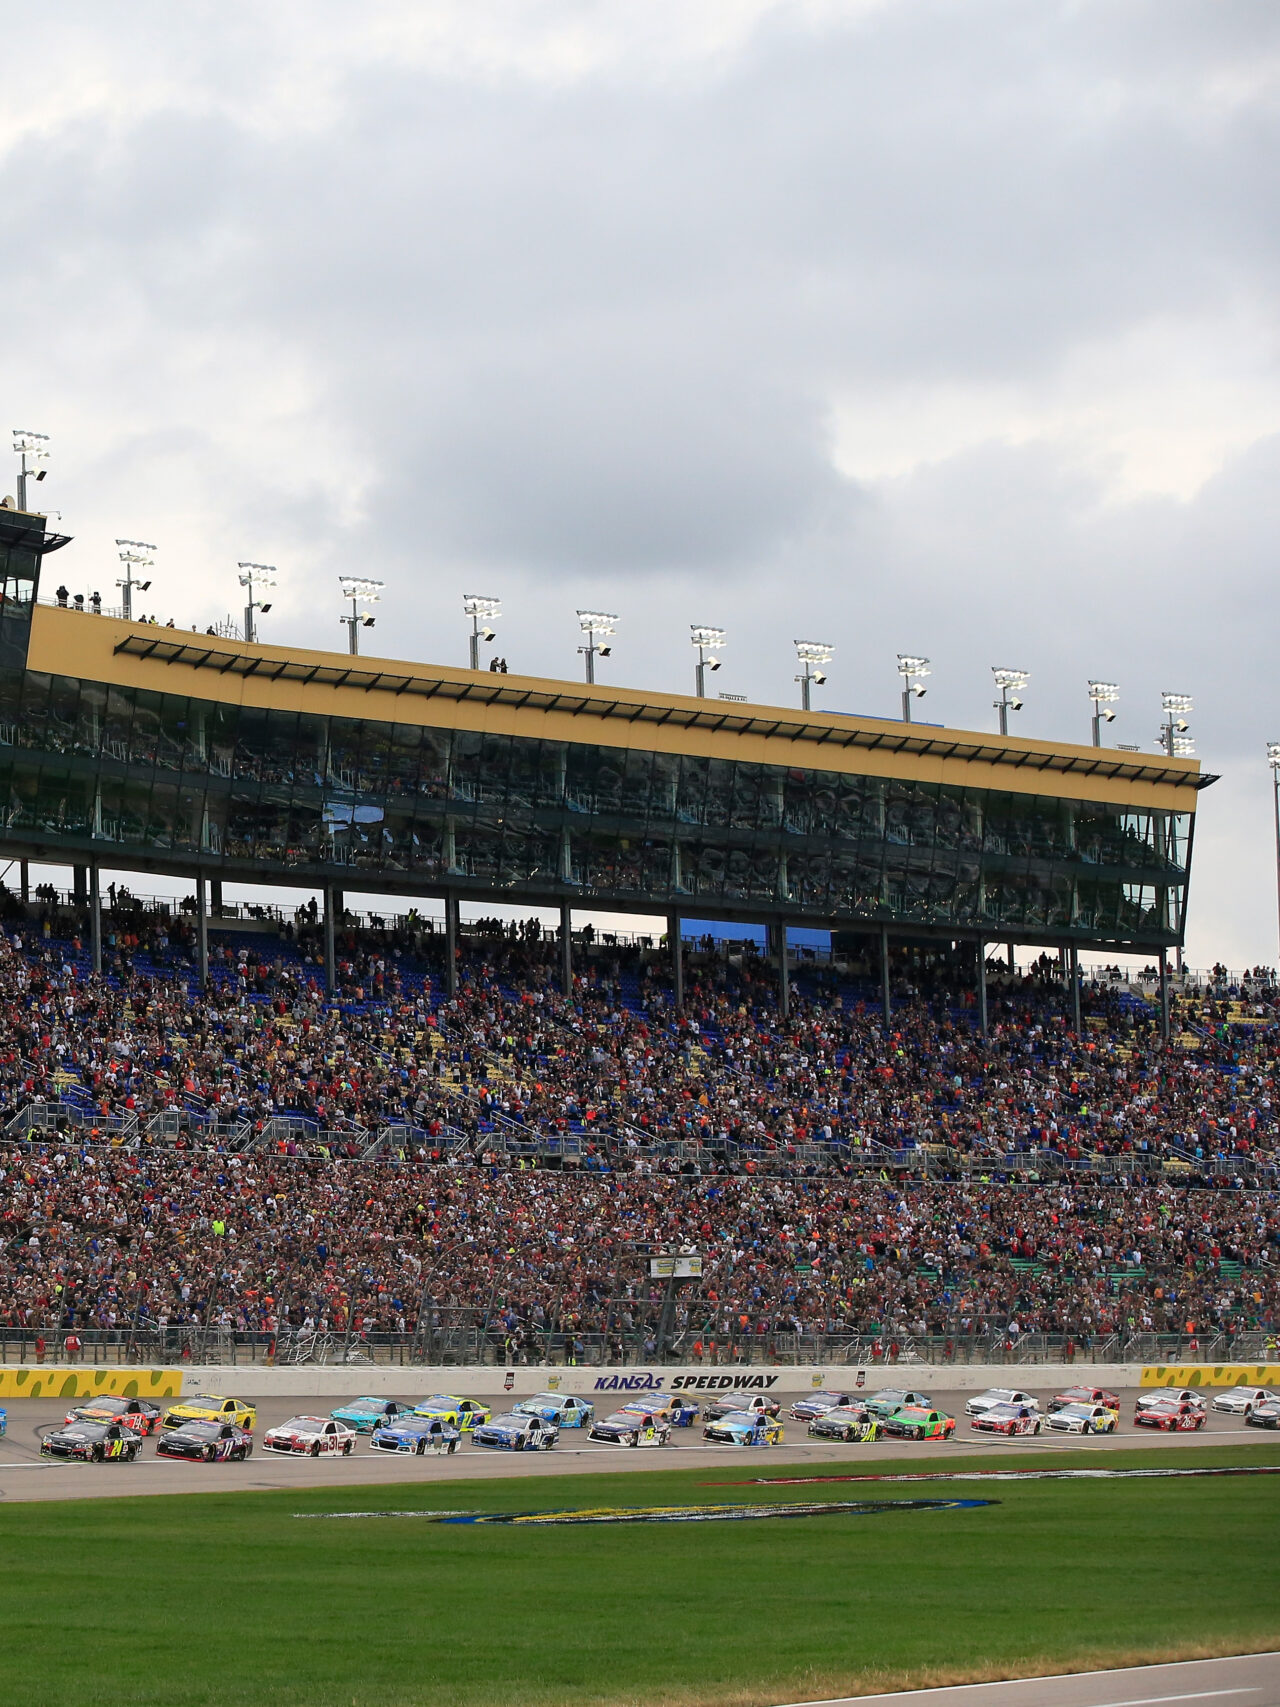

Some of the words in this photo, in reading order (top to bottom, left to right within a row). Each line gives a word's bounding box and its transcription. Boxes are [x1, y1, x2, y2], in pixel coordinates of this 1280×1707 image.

[594, 1373, 665, 1390] KANSAS
[671, 1375, 780, 1390] SPEEDWAY
[132, 1415, 142, 1430] 14
[461, 1412, 474, 1428] 27
[673, 1409, 681, 1422] 9
[1181, 1415, 1192, 1428] 26
[531, 1430, 542, 1446] 48
[646, 1427, 655, 1440] 15
[757, 1427, 768, 1441] 55
[110, 1440, 123, 1456] 24
[222, 1440, 234, 1456] 11
[328, 1435, 338, 1450] 31
